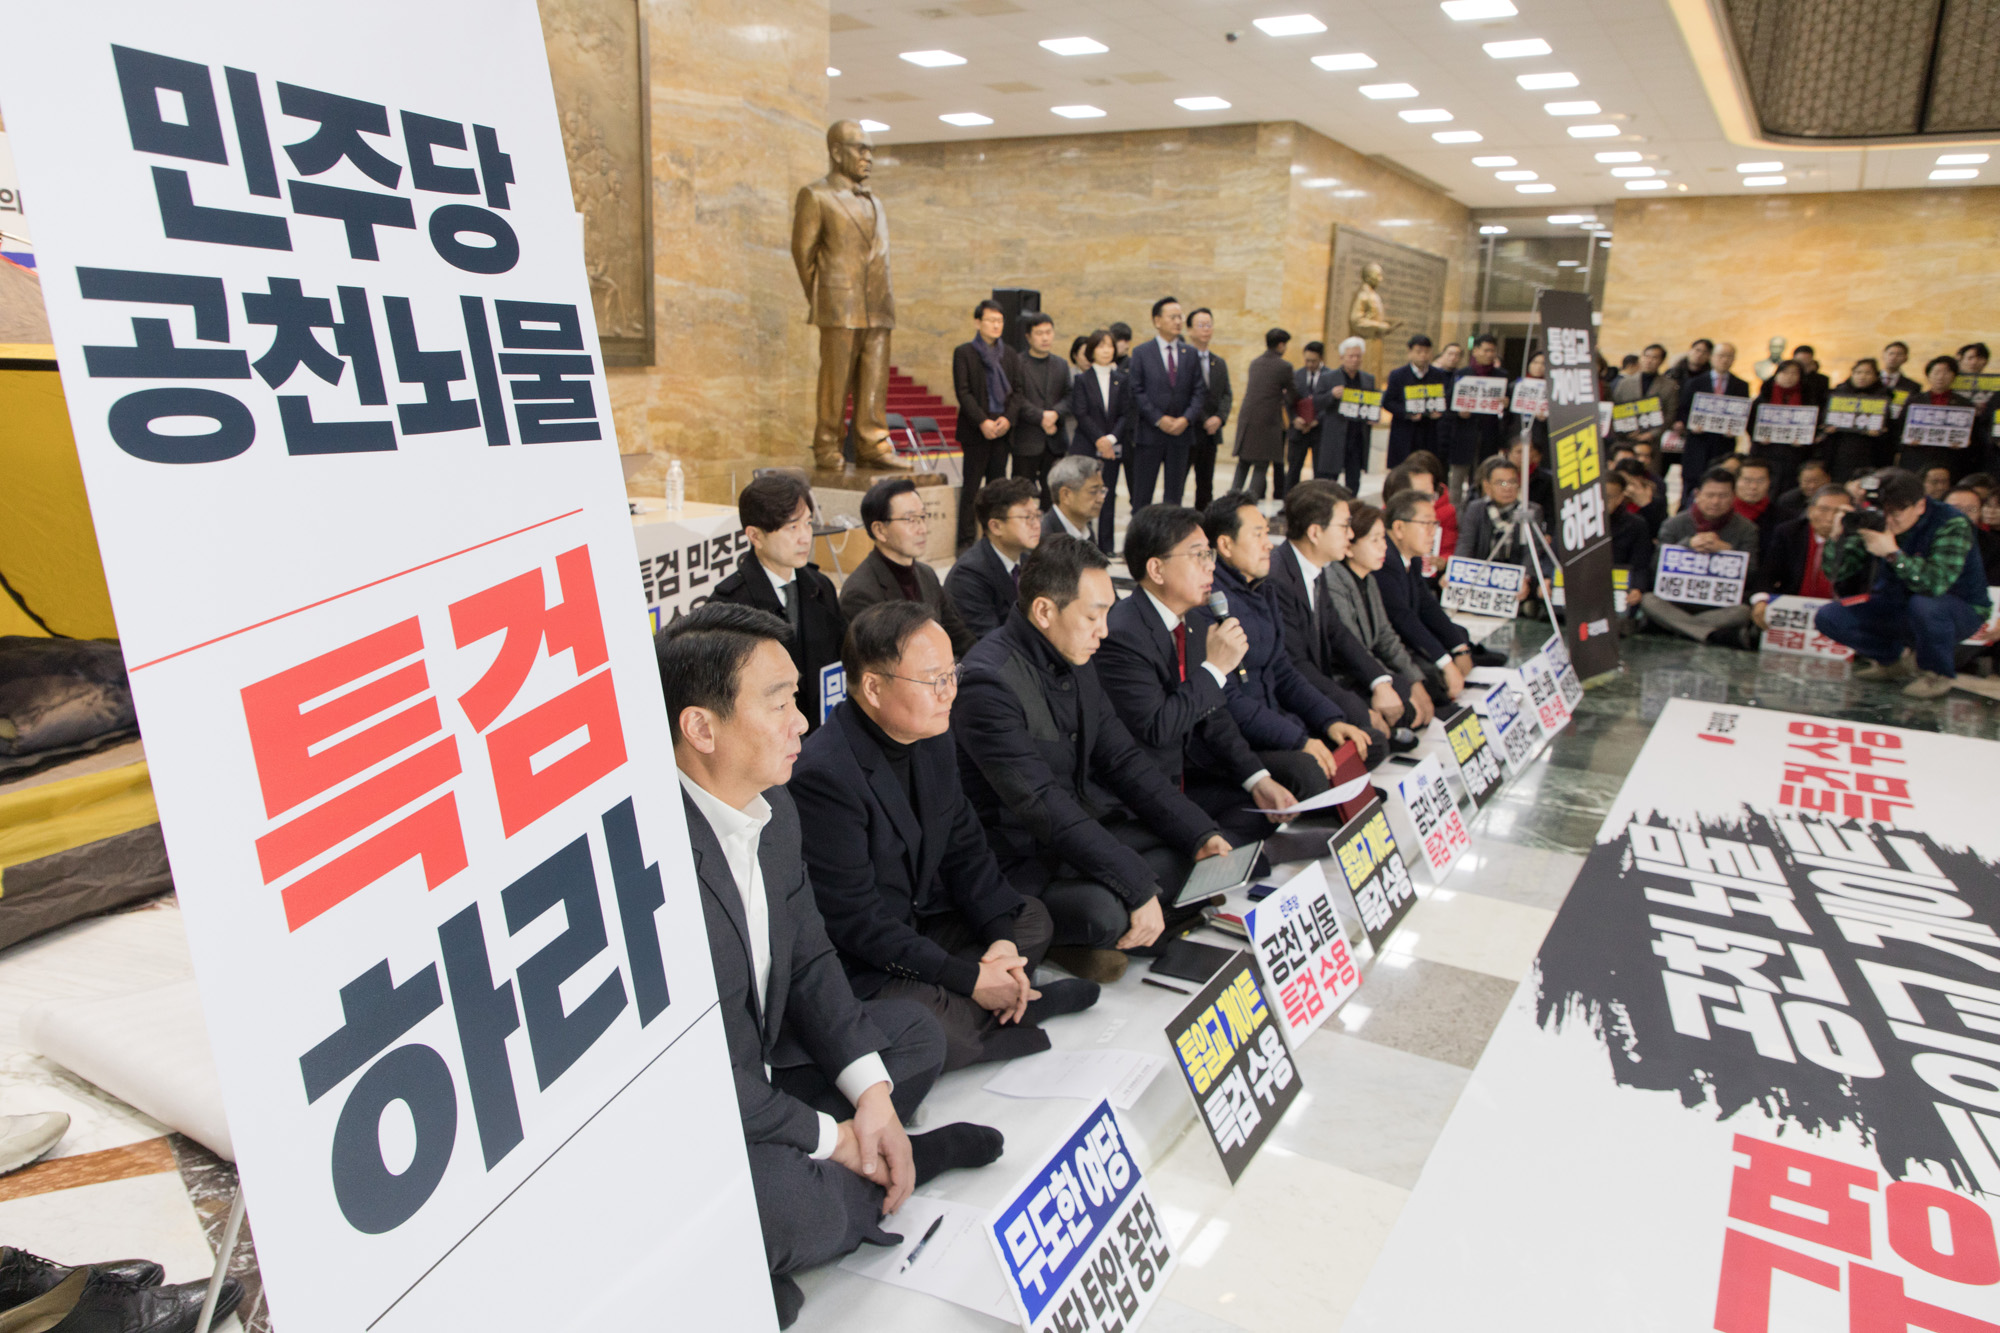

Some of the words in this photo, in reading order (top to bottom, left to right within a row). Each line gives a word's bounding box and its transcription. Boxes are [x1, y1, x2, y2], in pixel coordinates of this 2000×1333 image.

[111, 43, 520, 275] 민주당
[1547, 327, 1592, 366] 통일교
[1550, 368, 1595, 406] 게이트
[1556, 423, 1601, 491] 특검
[1561, 483, 1606, 552] 하라
[1489, 566, 1519, 591] 여당
[1665, 549, 1710, 576] 무도한
[1709, 554, 1743, 580] 여당
[1765, 629, 1807, 651] 특검
[1770, 607, 1810, 630] 공천
[239, 543, 629, 934] 특검
[1786, 721, 1906, 767] 수용
[1778, 761, 1915, 823] 특검
[1354, 875, 1394, 933] 특검
[1381, 853, 1414, 909] 수용
[1629, 822, 1814, 936] 뇌물
[1261, 912, 1307, 986] 공천
[1298, 893, 1339, 953] 뇌물
[298, 795, 672, 1236] 하라
[1280, 967, 1325, 1029] 특검
[1319, 938, 1356, 997] 수용
[1649, 914, 1886, 1079] 공천
[1175, 1004, 1236, 1094] 통일교
[1215, 967, 1269, 1051] 게이트
[1203, 1064, 1263, 1154] 특검
[1247, 1024, 1294, 1107] 수용
[1003, 1160, 1095, 1296] 무도한
[1074, 1112, 1131, 1208] 여당
[1080, 1236, 1140, 1333] 탄압
[1116, 1191, 1171, 1293] 중단
